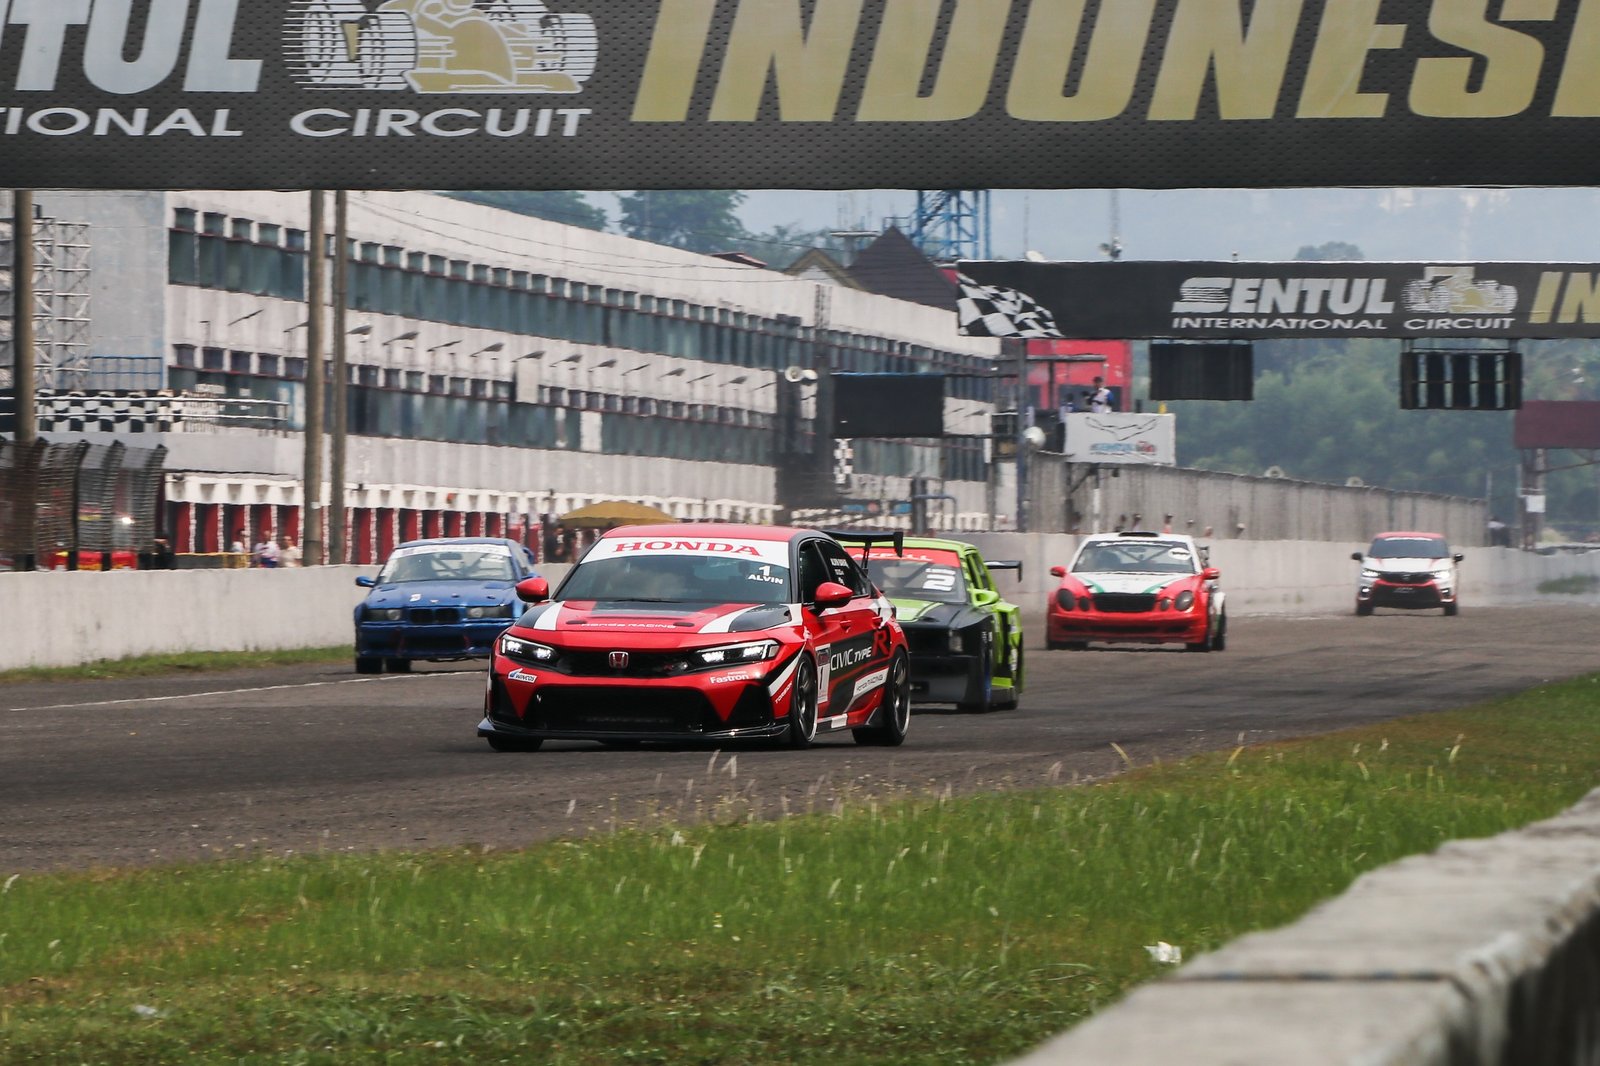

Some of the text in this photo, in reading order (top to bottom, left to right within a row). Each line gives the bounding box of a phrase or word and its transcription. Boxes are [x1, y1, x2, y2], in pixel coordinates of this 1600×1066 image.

[0, 0, 263, 95] TUL
[289, 108, 593, 138] CIRCUIT
[1171, 277, 1396, 315] SENTUL
[1172, 317, 1516, 331] INTERNATIONAL CIRCUIT
[612, 541, 763, 557] HONDA
[758, 565, 772, 576] 1
[747, 574, 784, 585] ALVIN
[922, 573, 956, 592] 2
[830, 648, 853, 671] CIVIC
[854, 646, 872, 663] TYPE
[871, 630, 890, 656] R
[710, 674, 749, 684] Fastron
